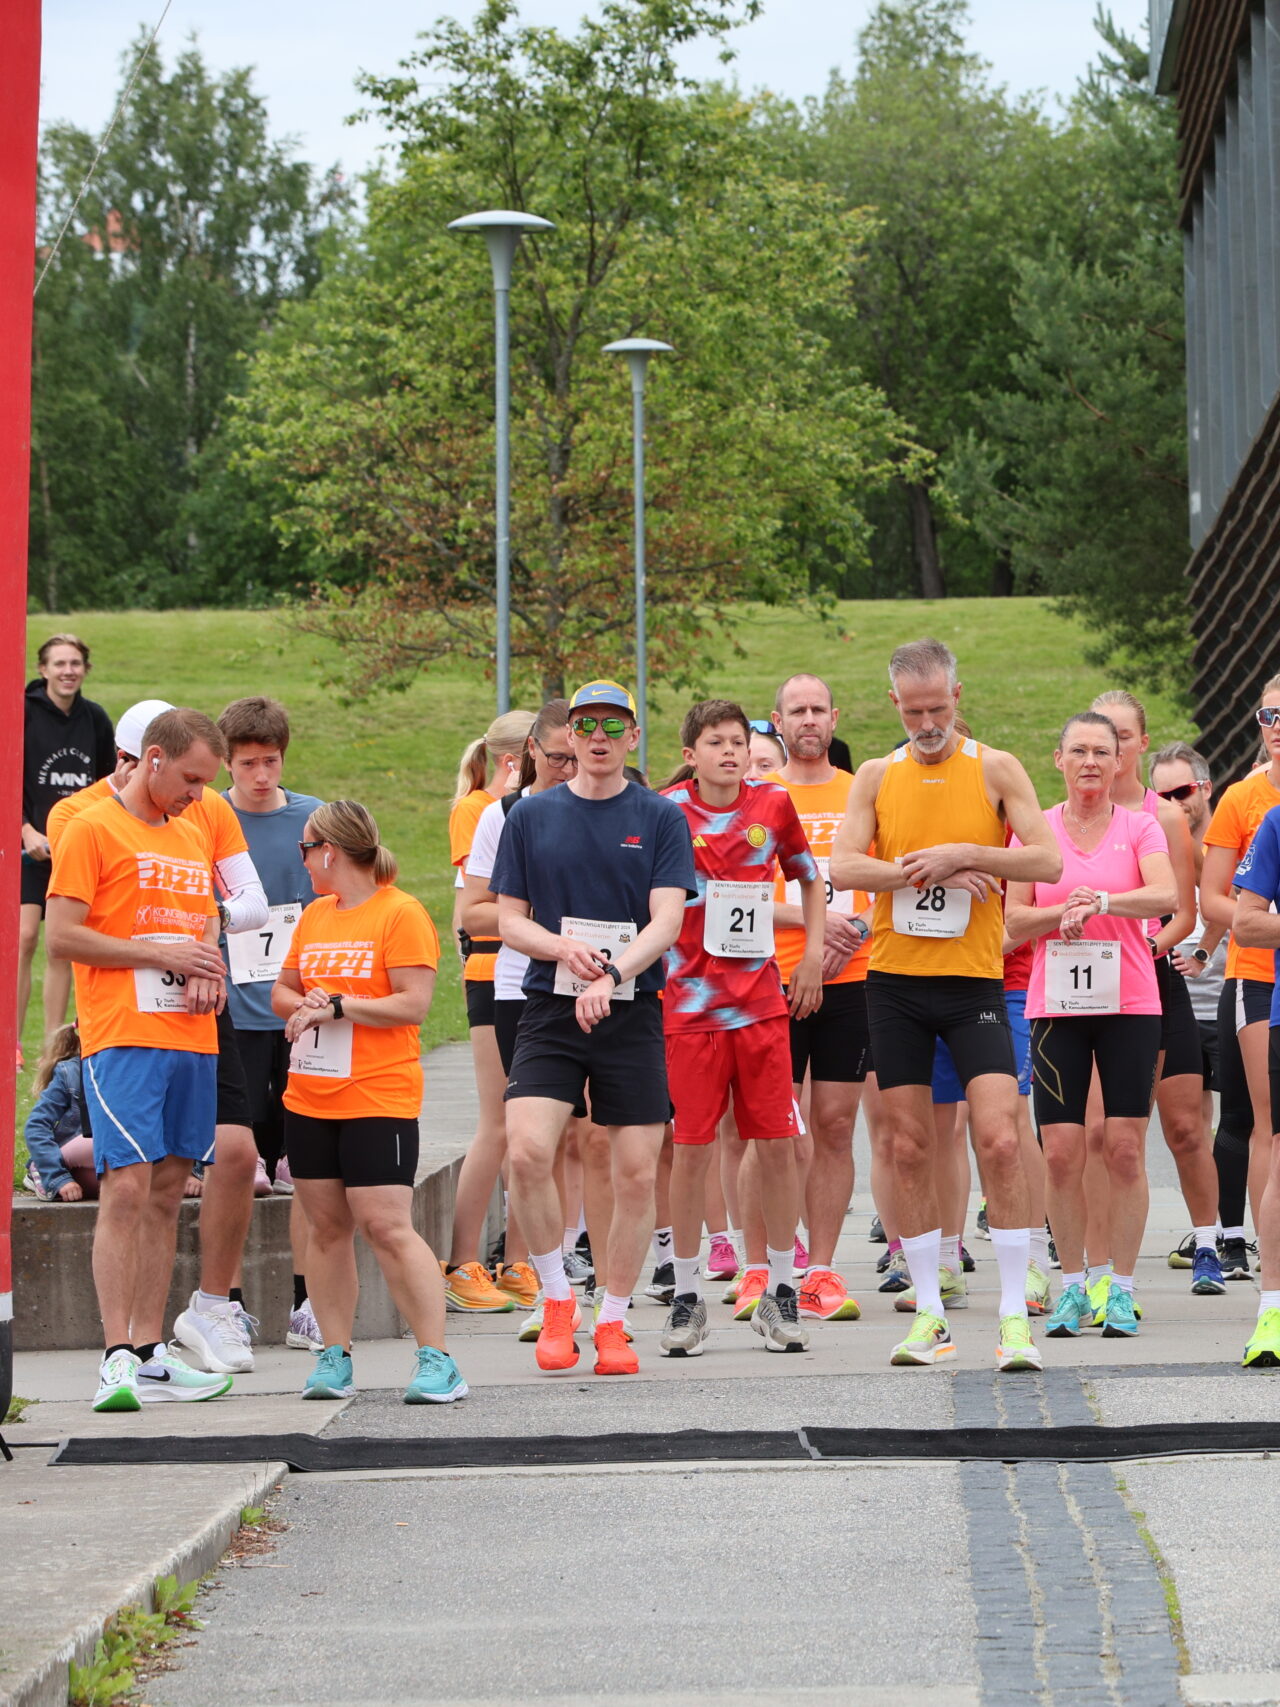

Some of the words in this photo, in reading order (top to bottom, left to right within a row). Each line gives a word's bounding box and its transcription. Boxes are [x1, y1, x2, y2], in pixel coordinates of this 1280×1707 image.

[915, 886, 946, 912] 28
[729, 907, 755, 933] 21
[259, 932, 274, 957] 7
[1070, 965, 1092, 989] 11
[313, 1026, 320, 1049] 1
